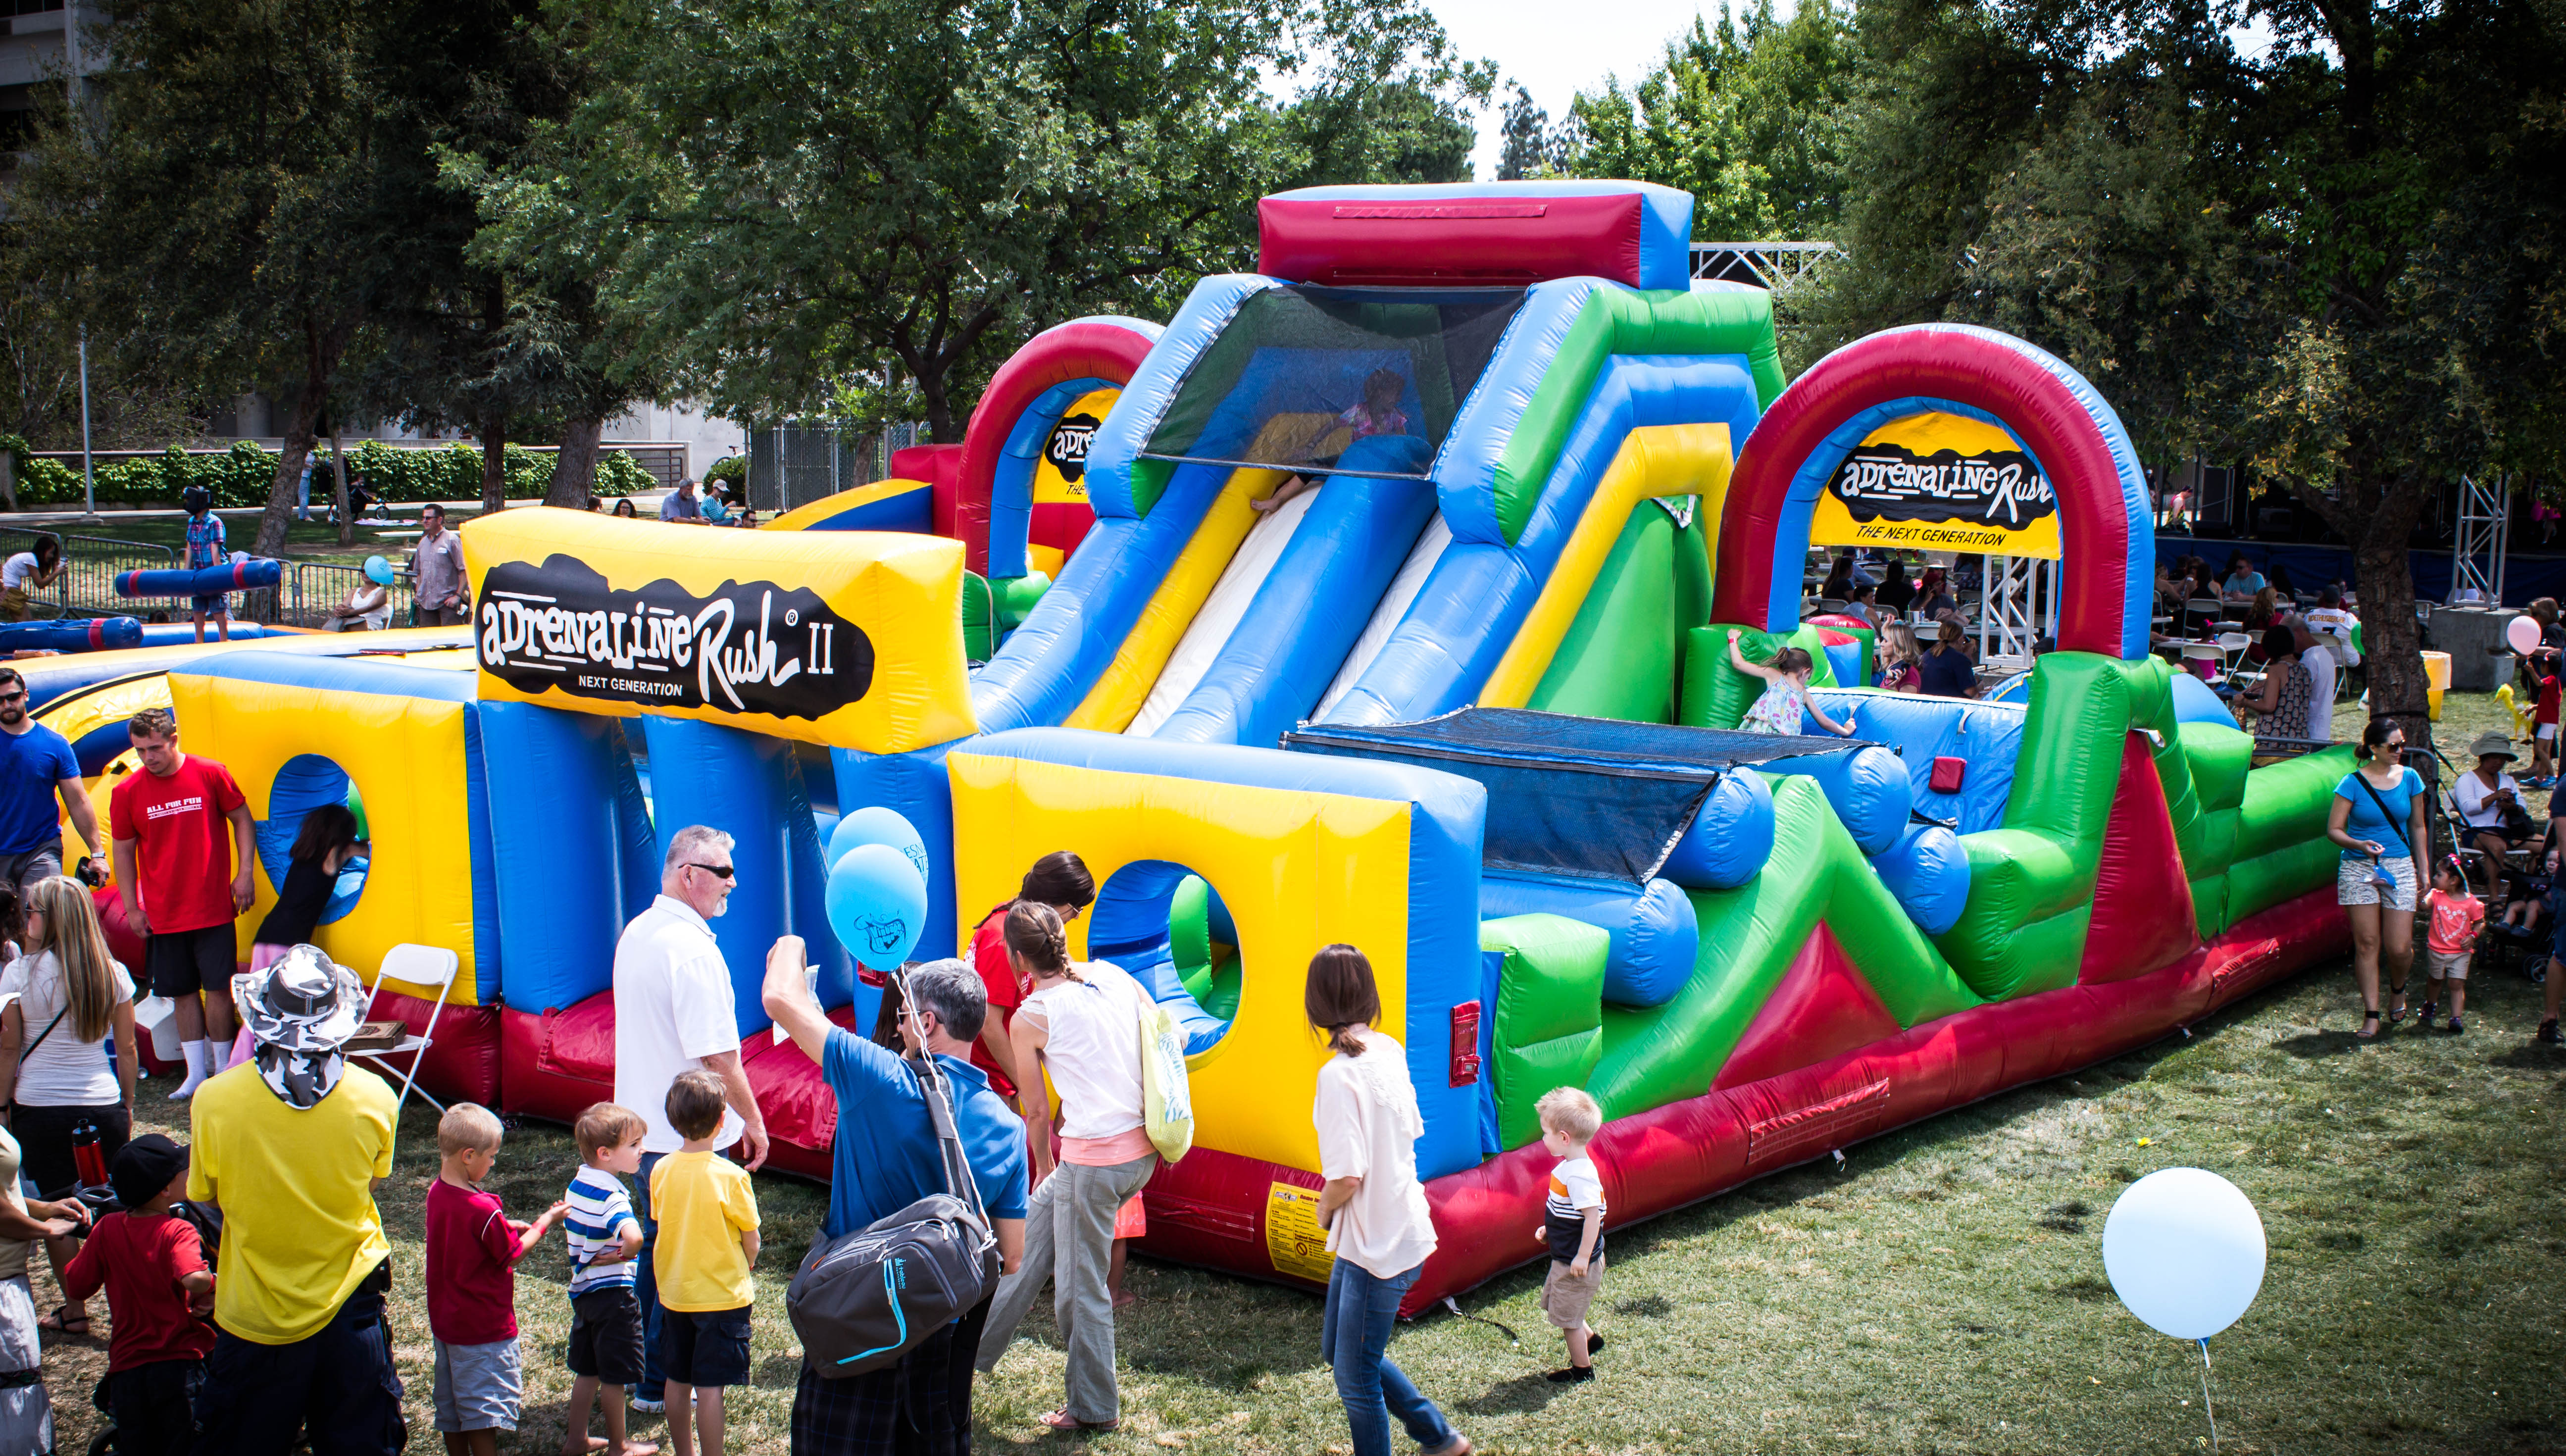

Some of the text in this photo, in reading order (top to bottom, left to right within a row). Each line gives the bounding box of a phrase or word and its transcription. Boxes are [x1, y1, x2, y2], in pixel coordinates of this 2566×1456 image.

[1066, 485, 1085, 495] THE
[1857, 525, 2006, 546] THE NEXT GENERATION
[807, 622, 835, 675] II
[578, 675, 683, 697] NEXT GENERATION
[147, 797, 202, 813] ALL FOR FUN
